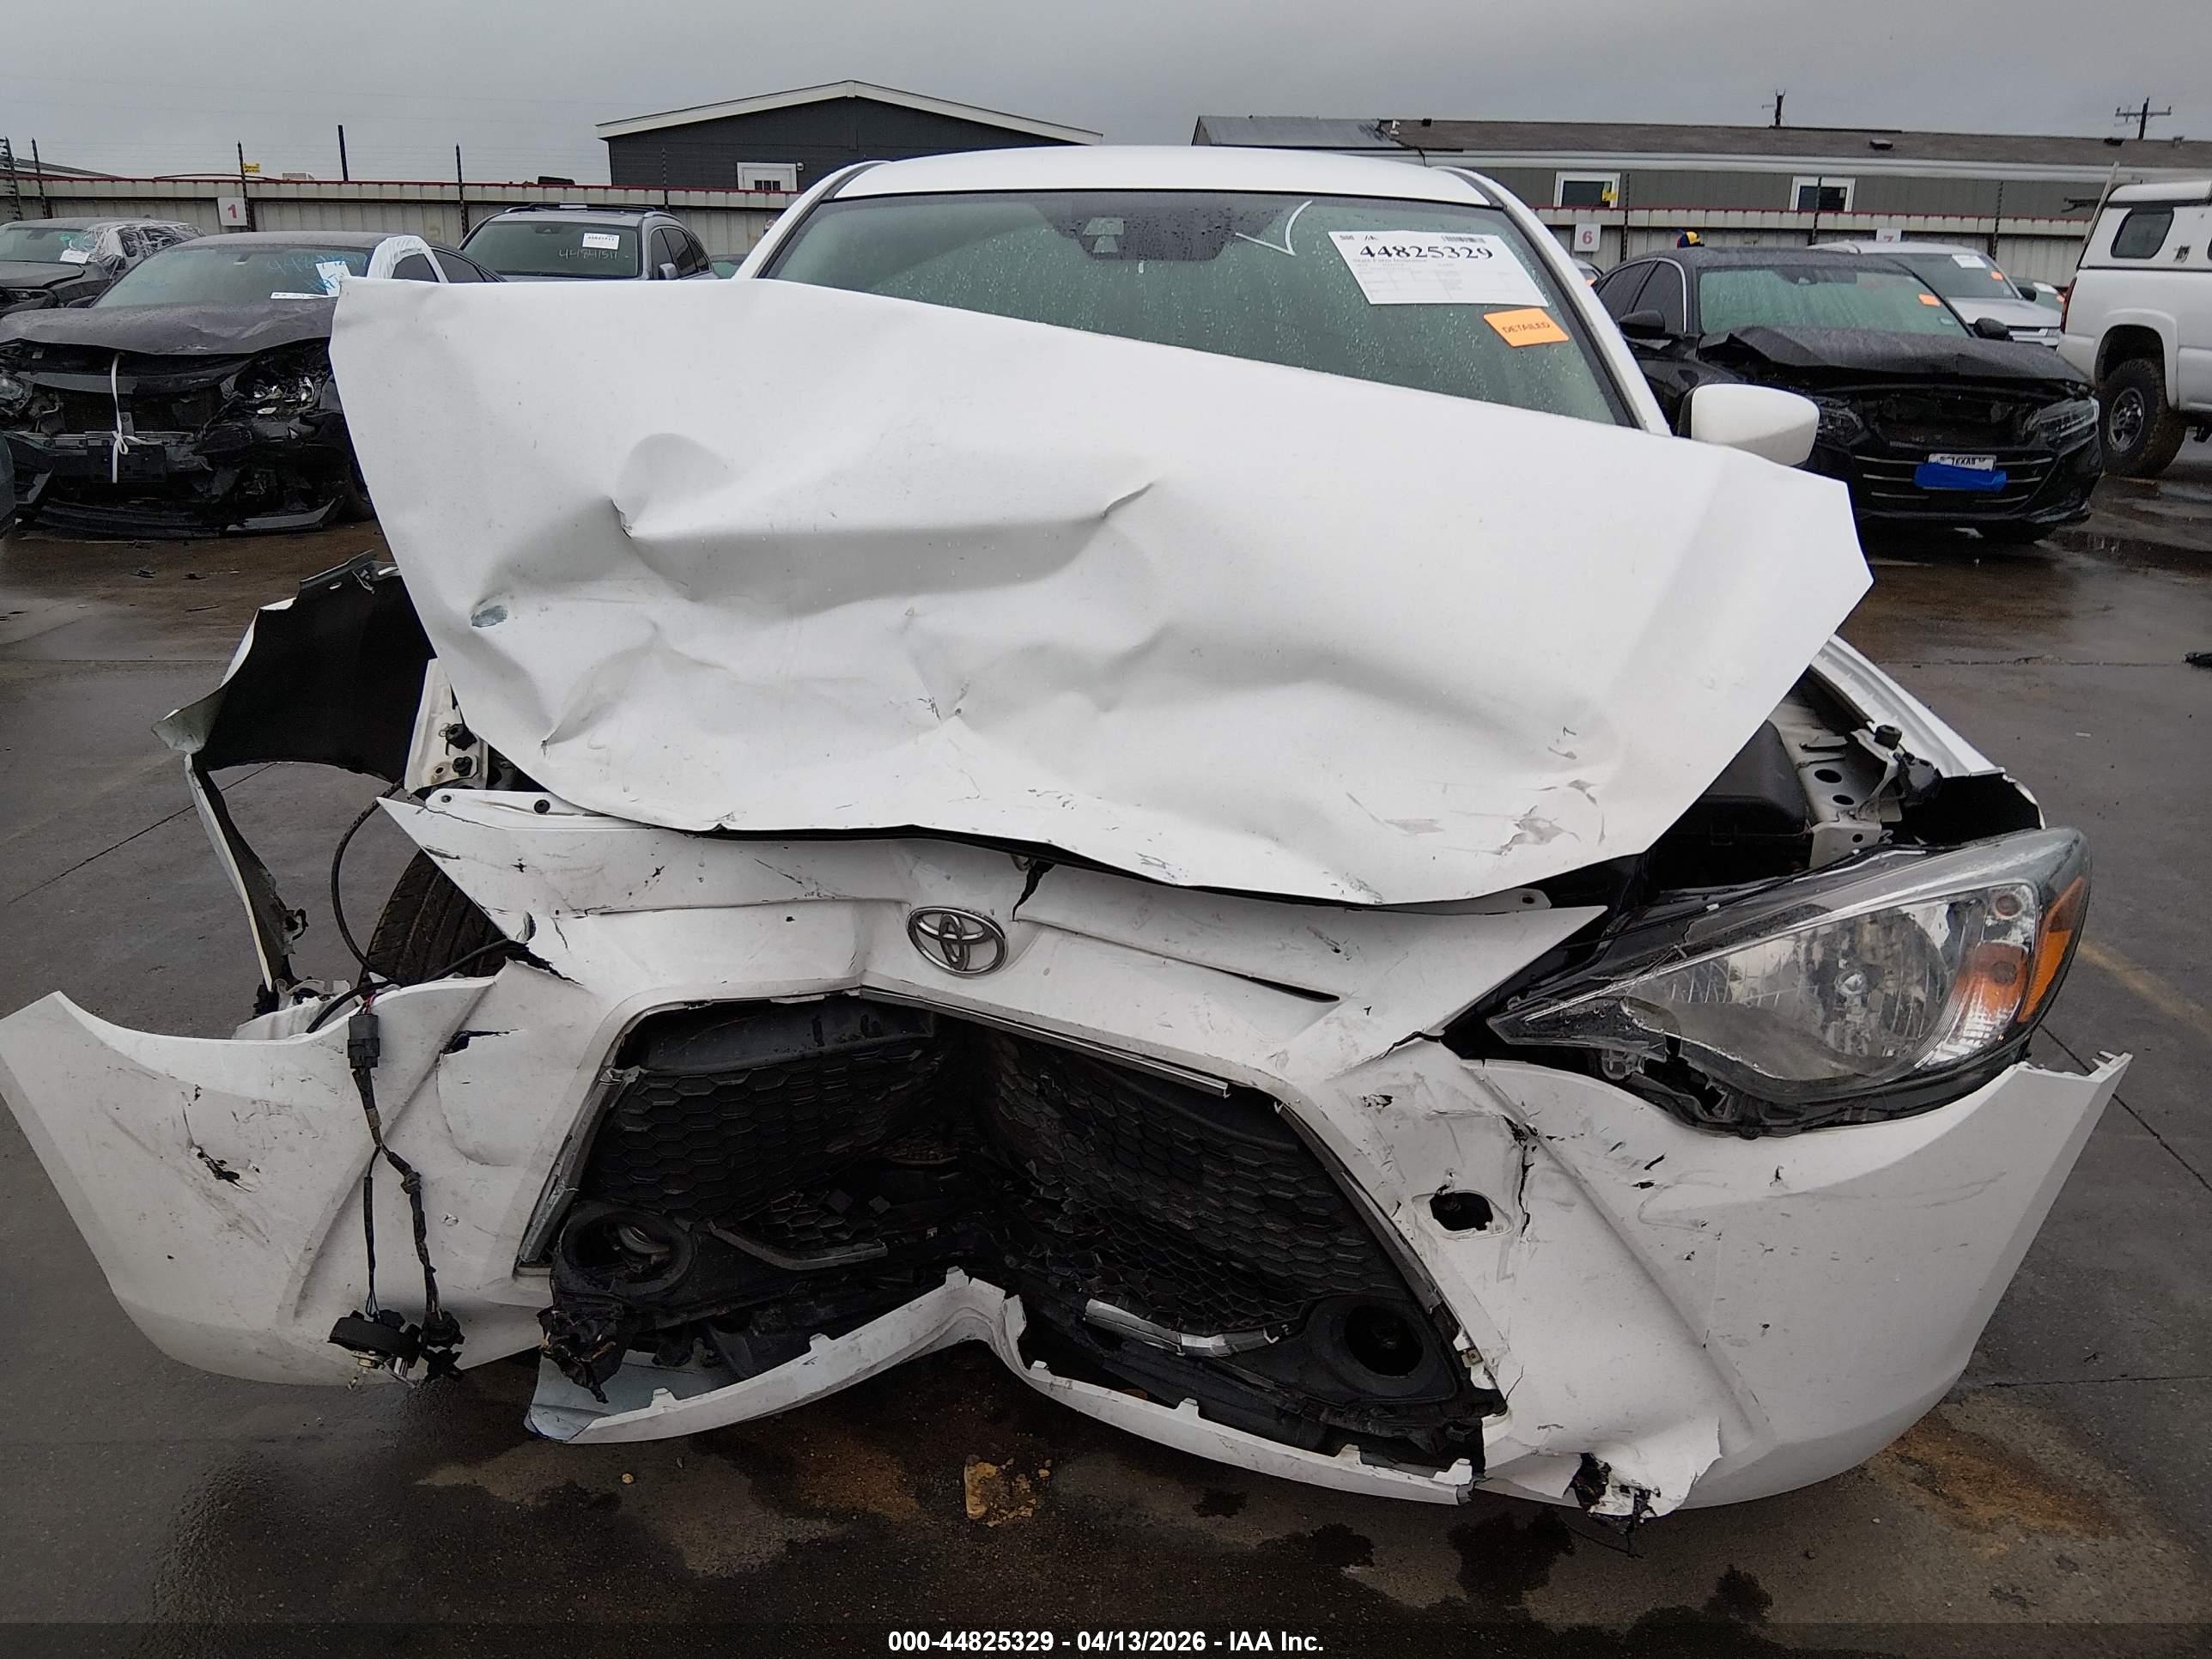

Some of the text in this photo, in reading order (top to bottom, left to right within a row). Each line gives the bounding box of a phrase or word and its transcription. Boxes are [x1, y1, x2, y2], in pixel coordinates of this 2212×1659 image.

[228, 204, 237, 219] 1
[1582, 230, 1594, 245] 6
[1360, 245, 1493, 259] 44825329
[1501, 321, 1551, 333] DETAILED
